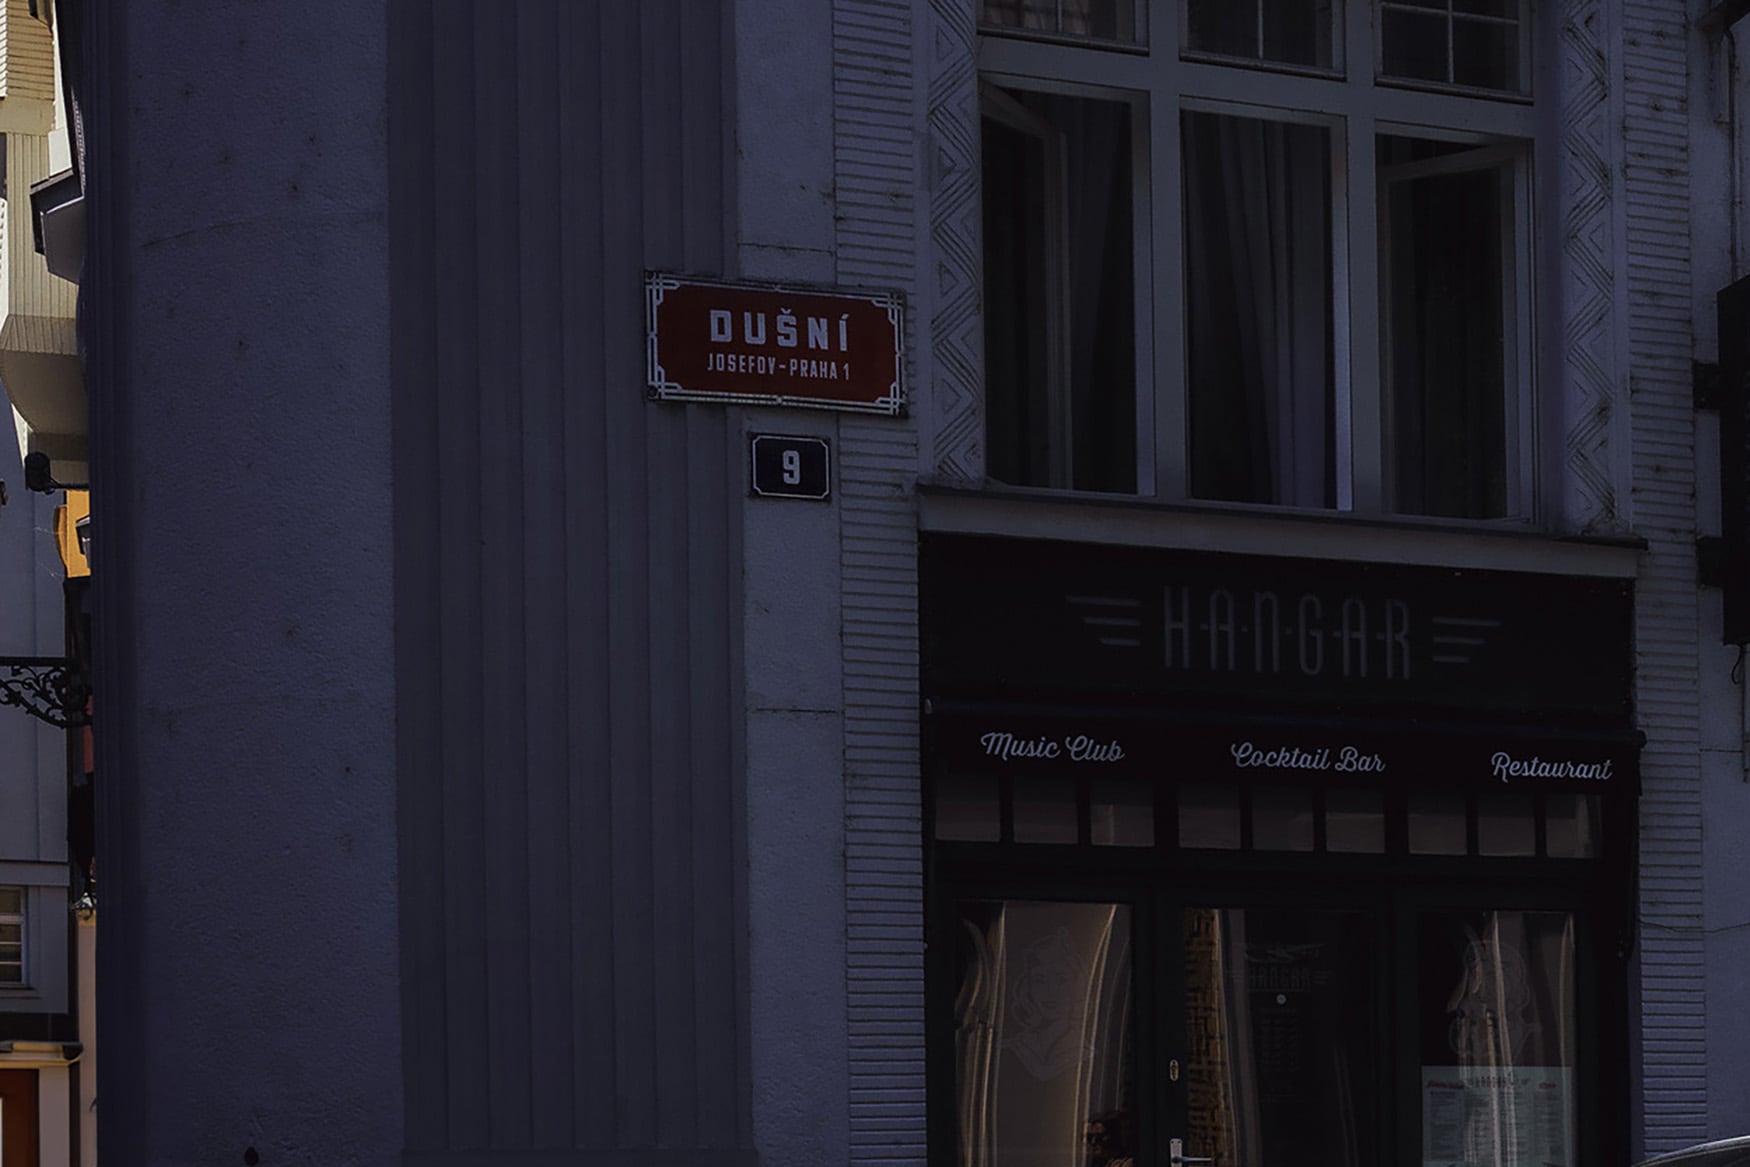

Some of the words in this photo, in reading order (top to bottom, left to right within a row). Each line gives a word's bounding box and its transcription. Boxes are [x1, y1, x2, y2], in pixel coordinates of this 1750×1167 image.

[709, 307, 850, 352] DUŠNÍ
[842, 363, 851, 382] 1
[782, 449, 801, 485] 9
[1163, 586, 1411, 681] HANGAR
[980, 732, 1061, 762] Music
[1065, 735, 1126, 763] Club
[1231, 741, 1331, 772] Cocktail
[1335, 747, 1387, 774] Bar
[1491, 751, 1613, 782] Restaurant
